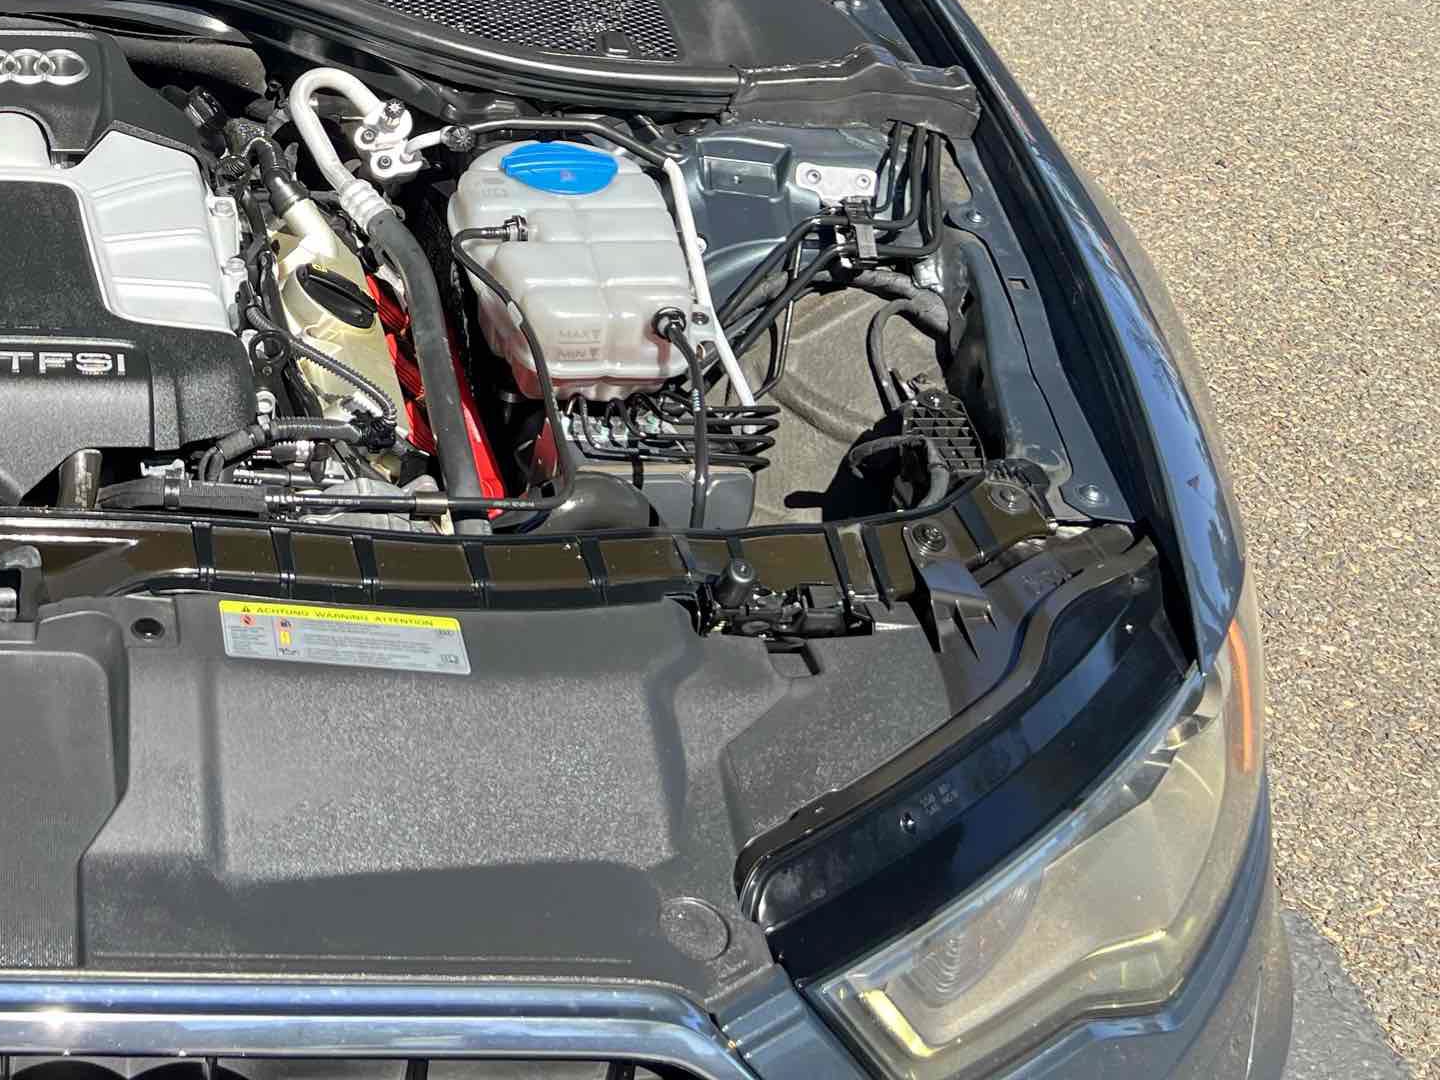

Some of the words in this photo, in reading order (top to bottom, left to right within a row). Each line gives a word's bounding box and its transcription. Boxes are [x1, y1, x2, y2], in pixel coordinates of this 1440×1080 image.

[256, 606, 310, 617] ACHTUNG
[314, 611, 369, 621] WARNING
[374, 615, 433, 626] ATTENTION
